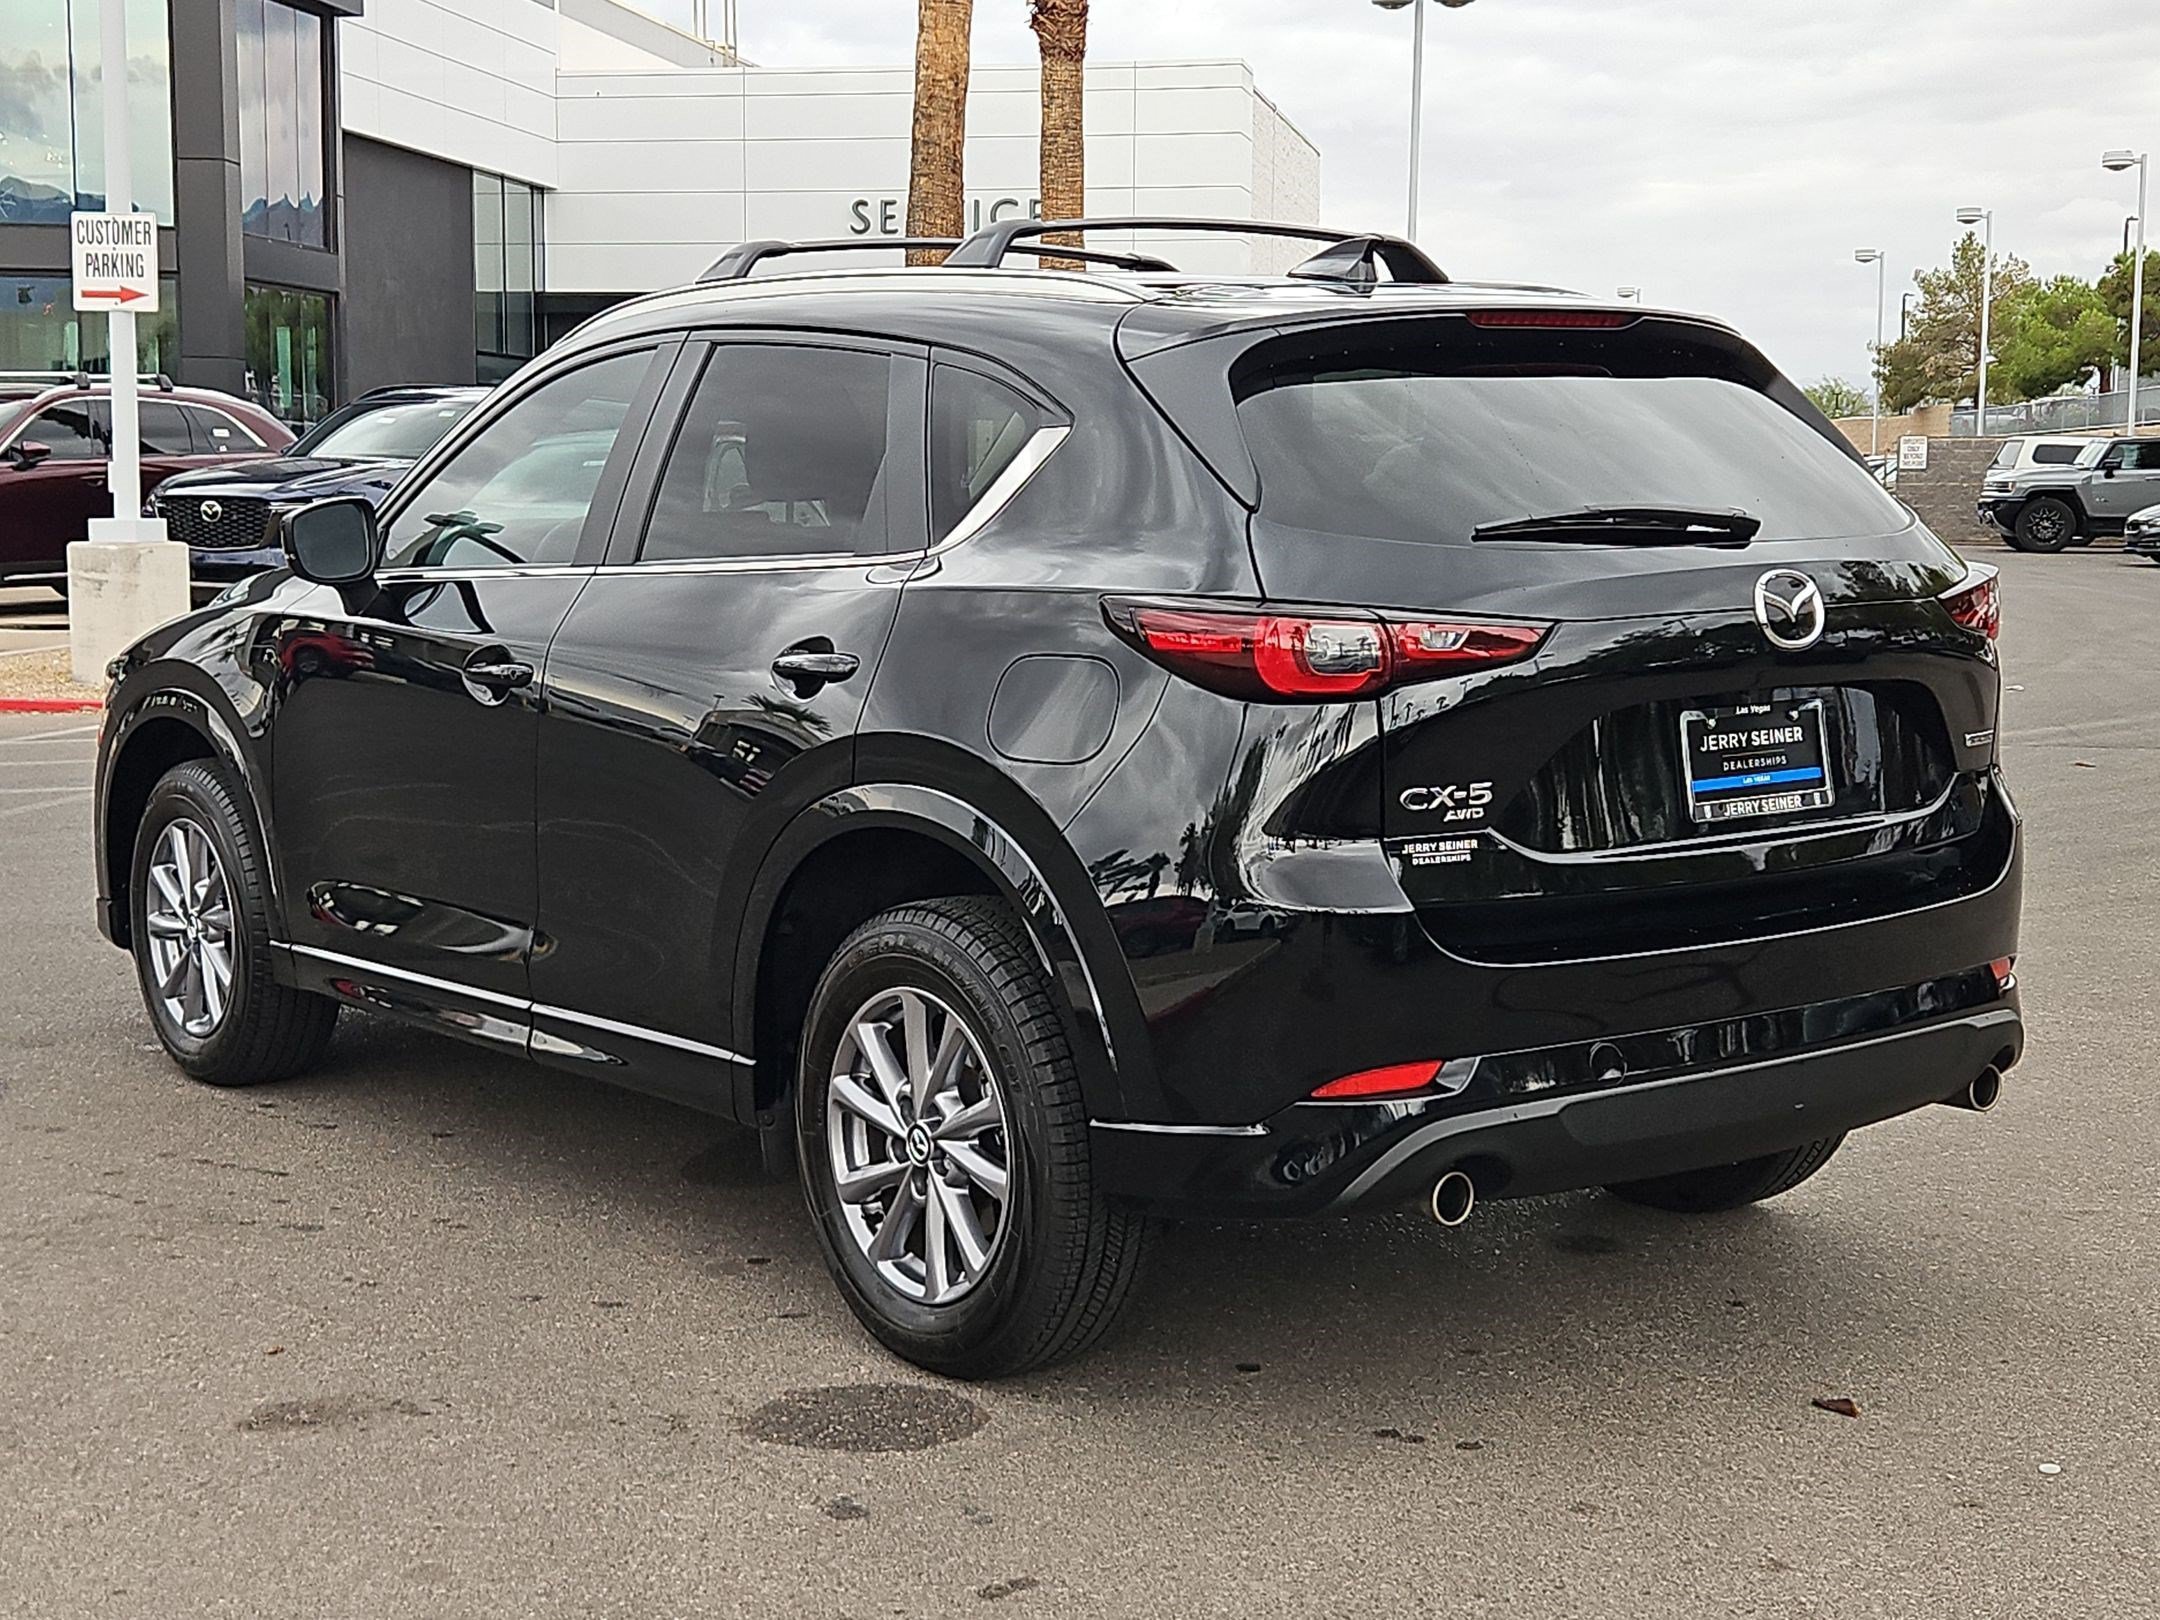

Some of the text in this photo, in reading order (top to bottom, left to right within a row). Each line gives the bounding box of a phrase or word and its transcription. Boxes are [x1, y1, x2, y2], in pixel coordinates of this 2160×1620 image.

[850, 197, 1042, 234] SEIC
[76, 219, 151, 245] CUSTOMER
[85, 252, 144, 278] PARKING
[1735, 704, 1771, 715] Las Vegas
[1700, 726, 1803, 752] JERRY SEINER
[1723, 755, 1787, 771] DEALERSHIPS
[1399, 782, 1493, 811] CX-5
[1723, 802, 1760, 817] JERRY
[1762, 795, 1802, 812] SEINER
[1443, 807, 1485, 822] AWD
[1402, 839, 1478, 854] JERRY SEINER
[1412, 853, 1472, 866] DEALERSHIPS
